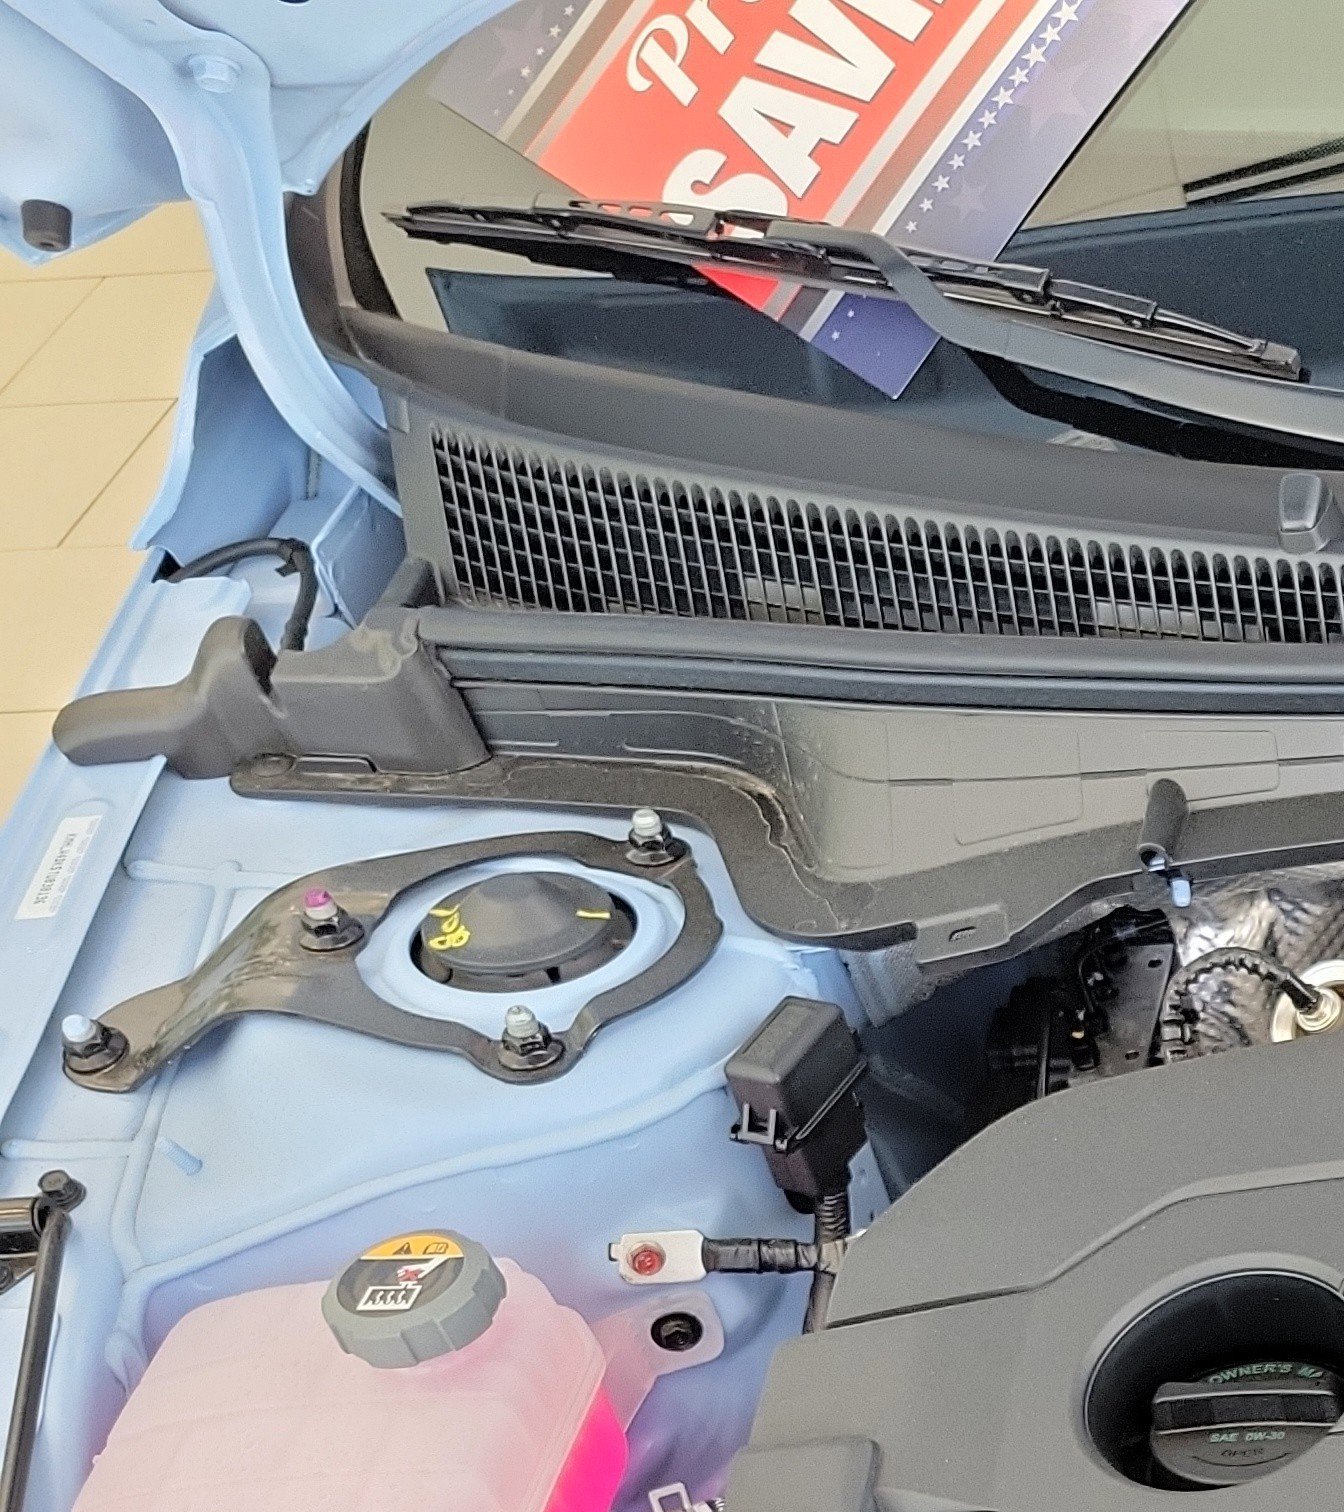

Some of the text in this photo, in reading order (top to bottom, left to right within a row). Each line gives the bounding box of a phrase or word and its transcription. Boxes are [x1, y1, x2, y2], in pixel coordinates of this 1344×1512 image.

[1208, 1363, 1293, 1384] OWNER'S
[1209, 1431, 1286, 1443] SAE 0W-30
